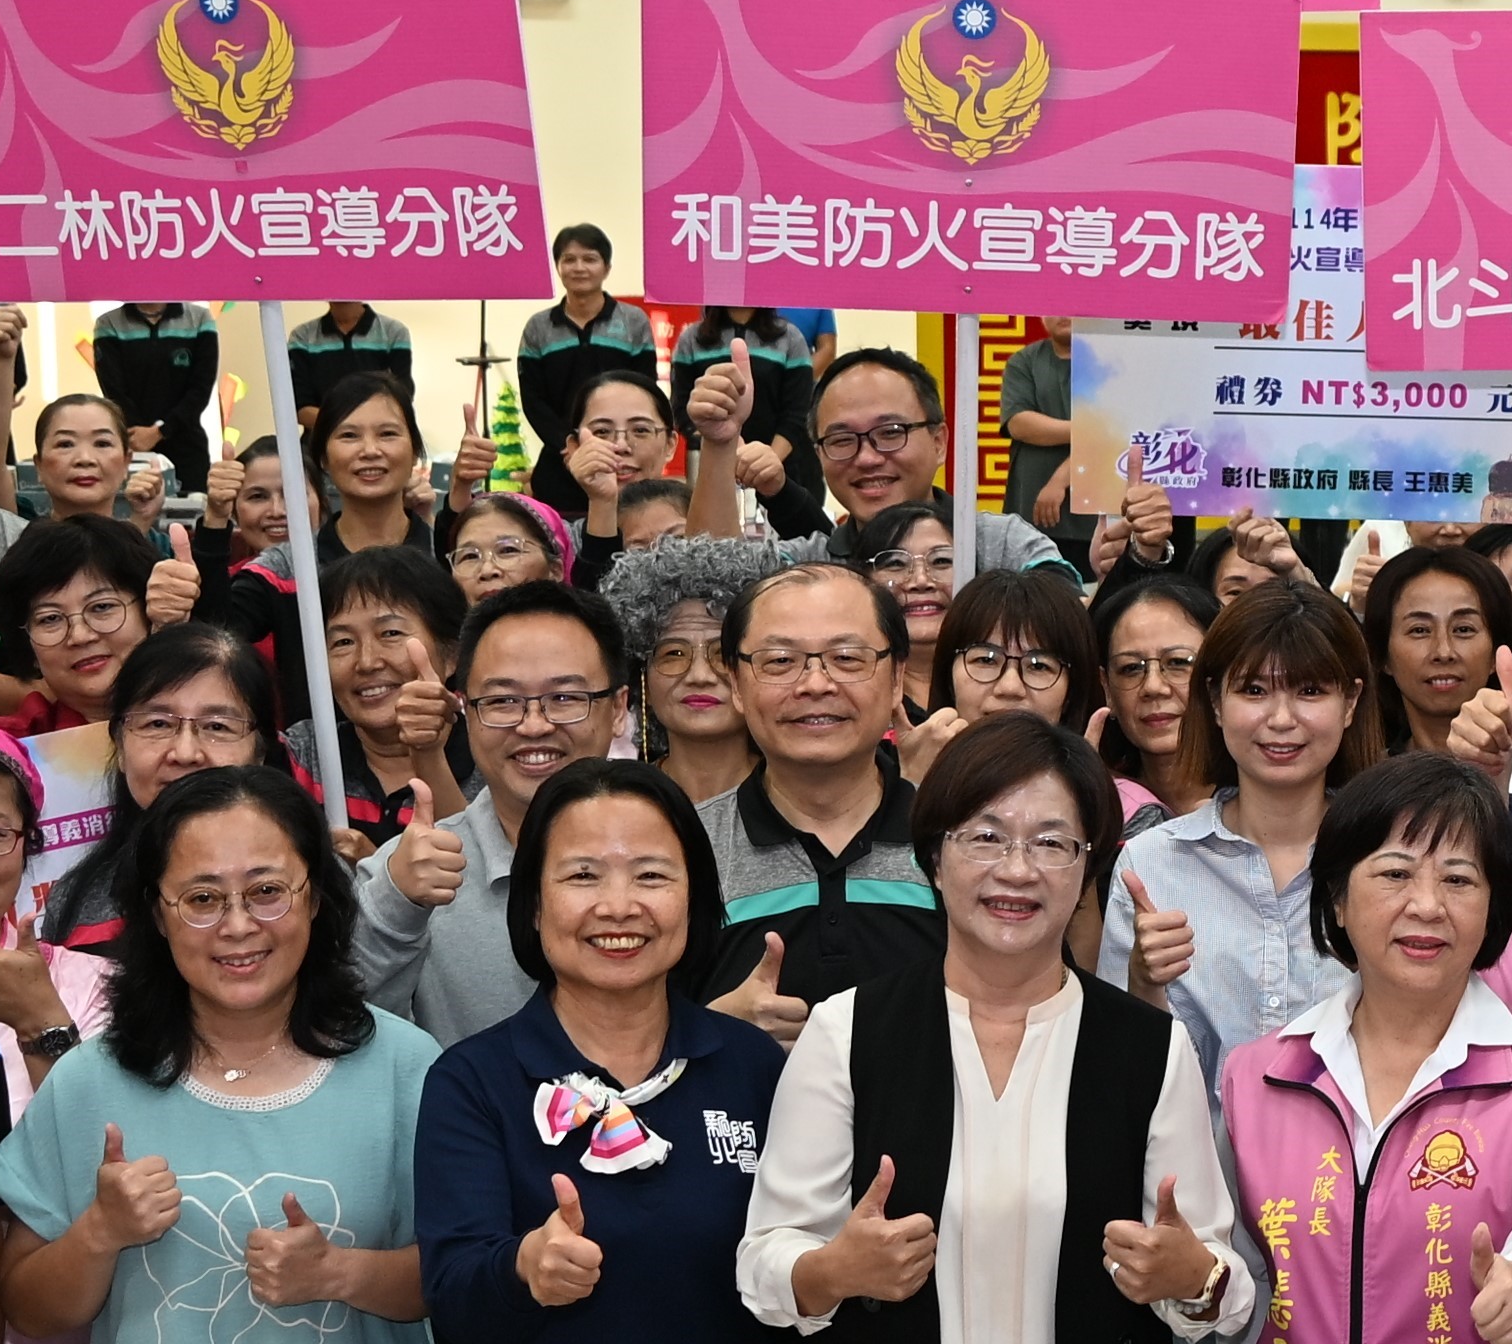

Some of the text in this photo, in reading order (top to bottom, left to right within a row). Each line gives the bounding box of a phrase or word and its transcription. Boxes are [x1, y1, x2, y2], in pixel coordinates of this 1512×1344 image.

[672, 192, 1266, 281] 和美防火宣導分隊
[1301, 380, 1468, 410] NT$3,000
[1222, 469, 1473, 494] 彰化縣政府 縣長 王惠美
[1309, 1146, 1343, 1236] 大隊長
